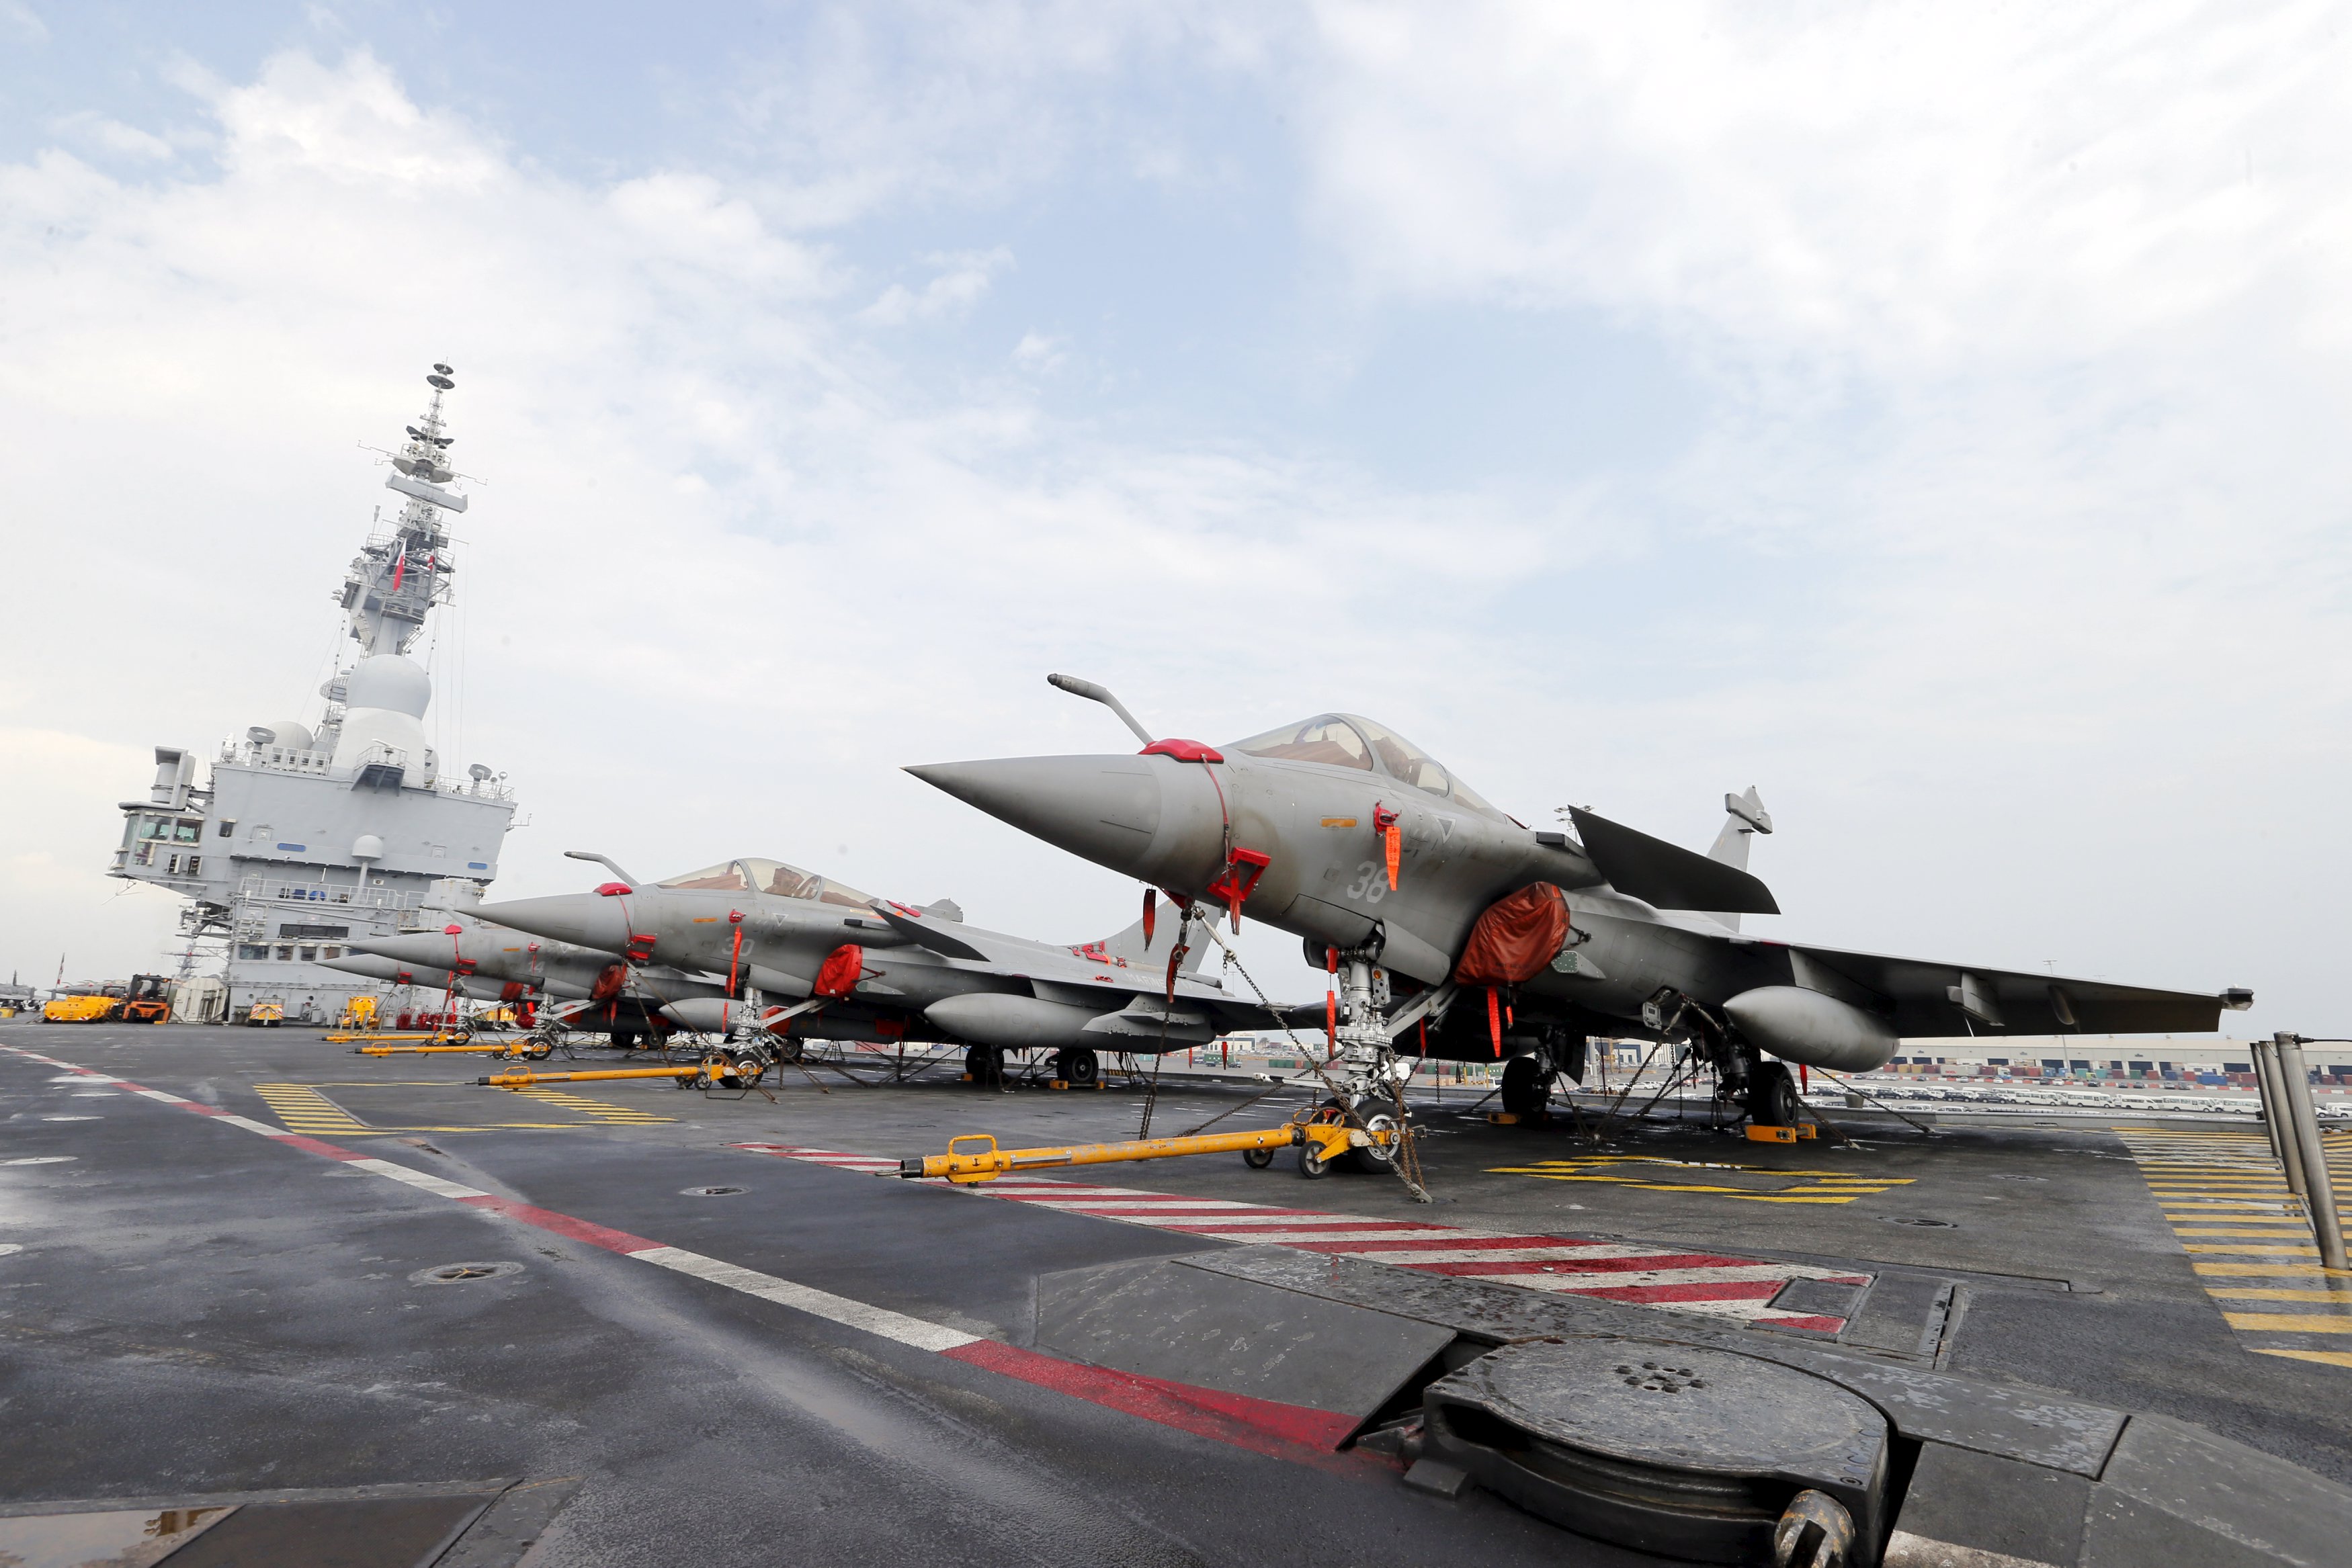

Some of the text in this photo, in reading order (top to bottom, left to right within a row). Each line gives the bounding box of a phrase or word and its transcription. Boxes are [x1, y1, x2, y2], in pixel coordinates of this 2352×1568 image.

[1347, 860, 1390, 904] 38
[721, 936, 755, 957] 30
[1126, 972, 1167, 989] MARINE
